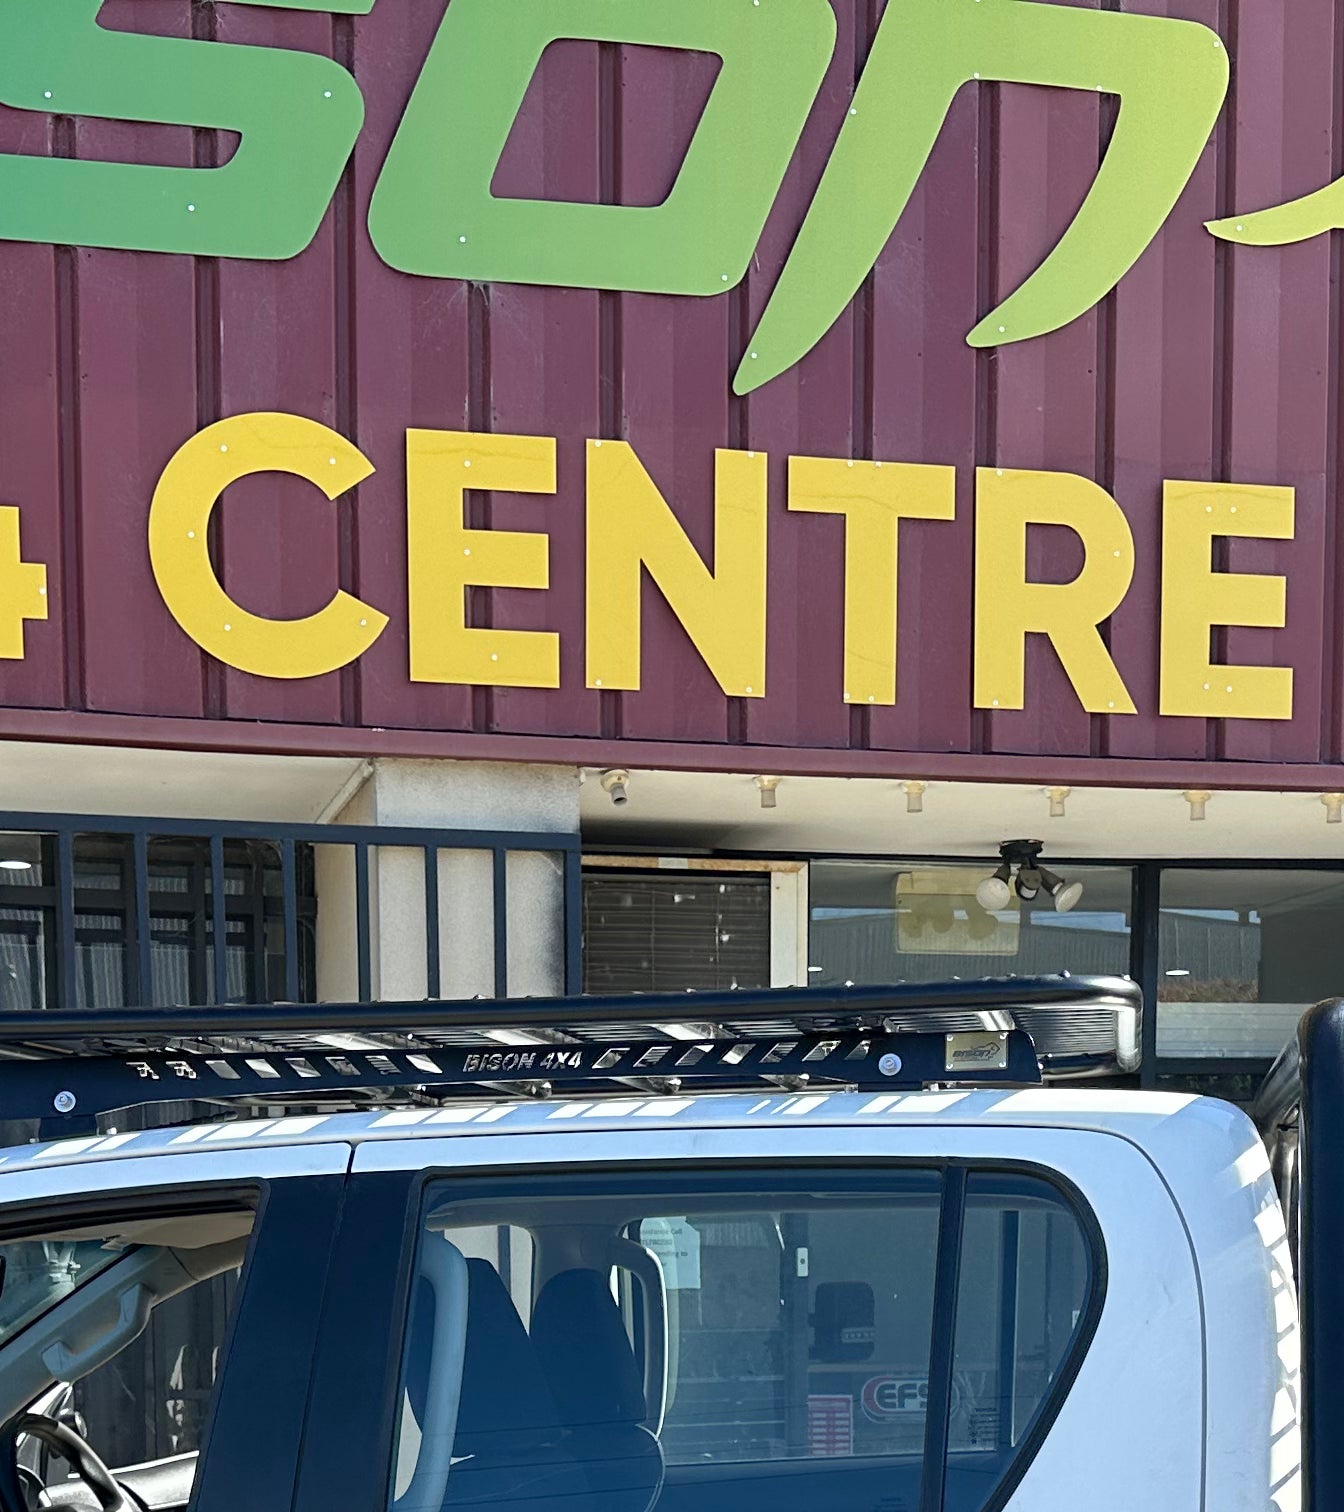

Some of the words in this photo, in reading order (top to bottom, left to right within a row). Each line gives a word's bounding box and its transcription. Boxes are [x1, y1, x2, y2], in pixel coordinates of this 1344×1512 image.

[147, 411, 1297, 721] CENTRE
[462, 1053, 536, 1073] BISON
[539, 1051, 583, 1070] 4X4
